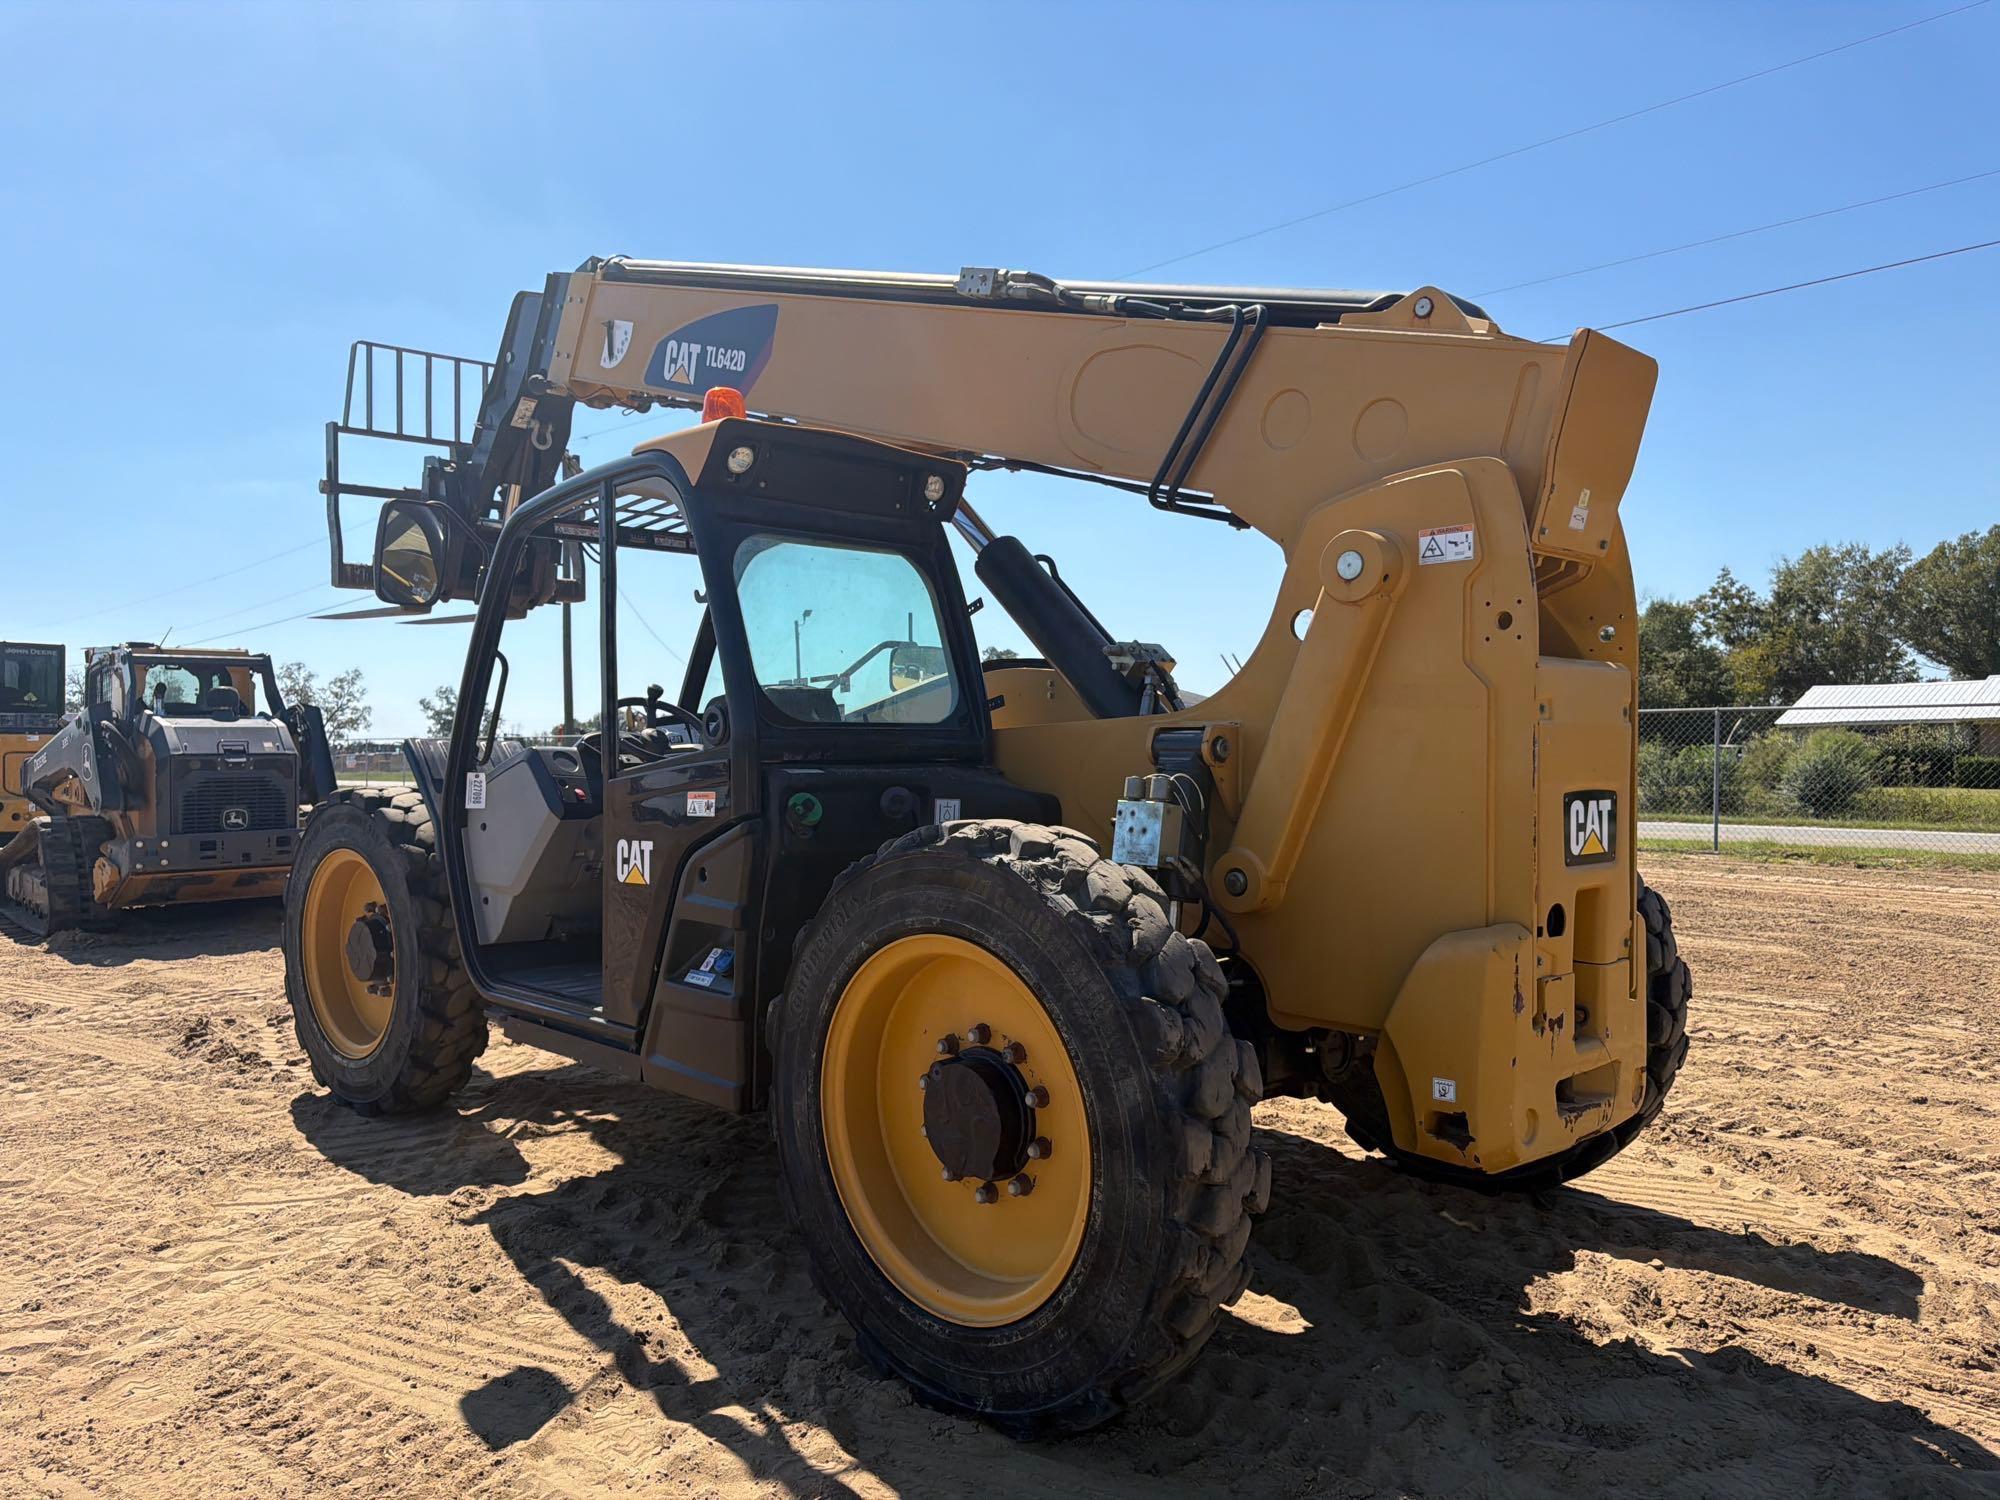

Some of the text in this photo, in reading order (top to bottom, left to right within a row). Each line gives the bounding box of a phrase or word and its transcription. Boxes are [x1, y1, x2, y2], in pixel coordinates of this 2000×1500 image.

[663, 339, 701, 385] CAT
[706, 345, 746, 372] TL642D
[5, 647, 57, 656] JOHN DEERE
[1570, 799, 1612, 856] CAT
[616, 838, 654, 885] CAT
